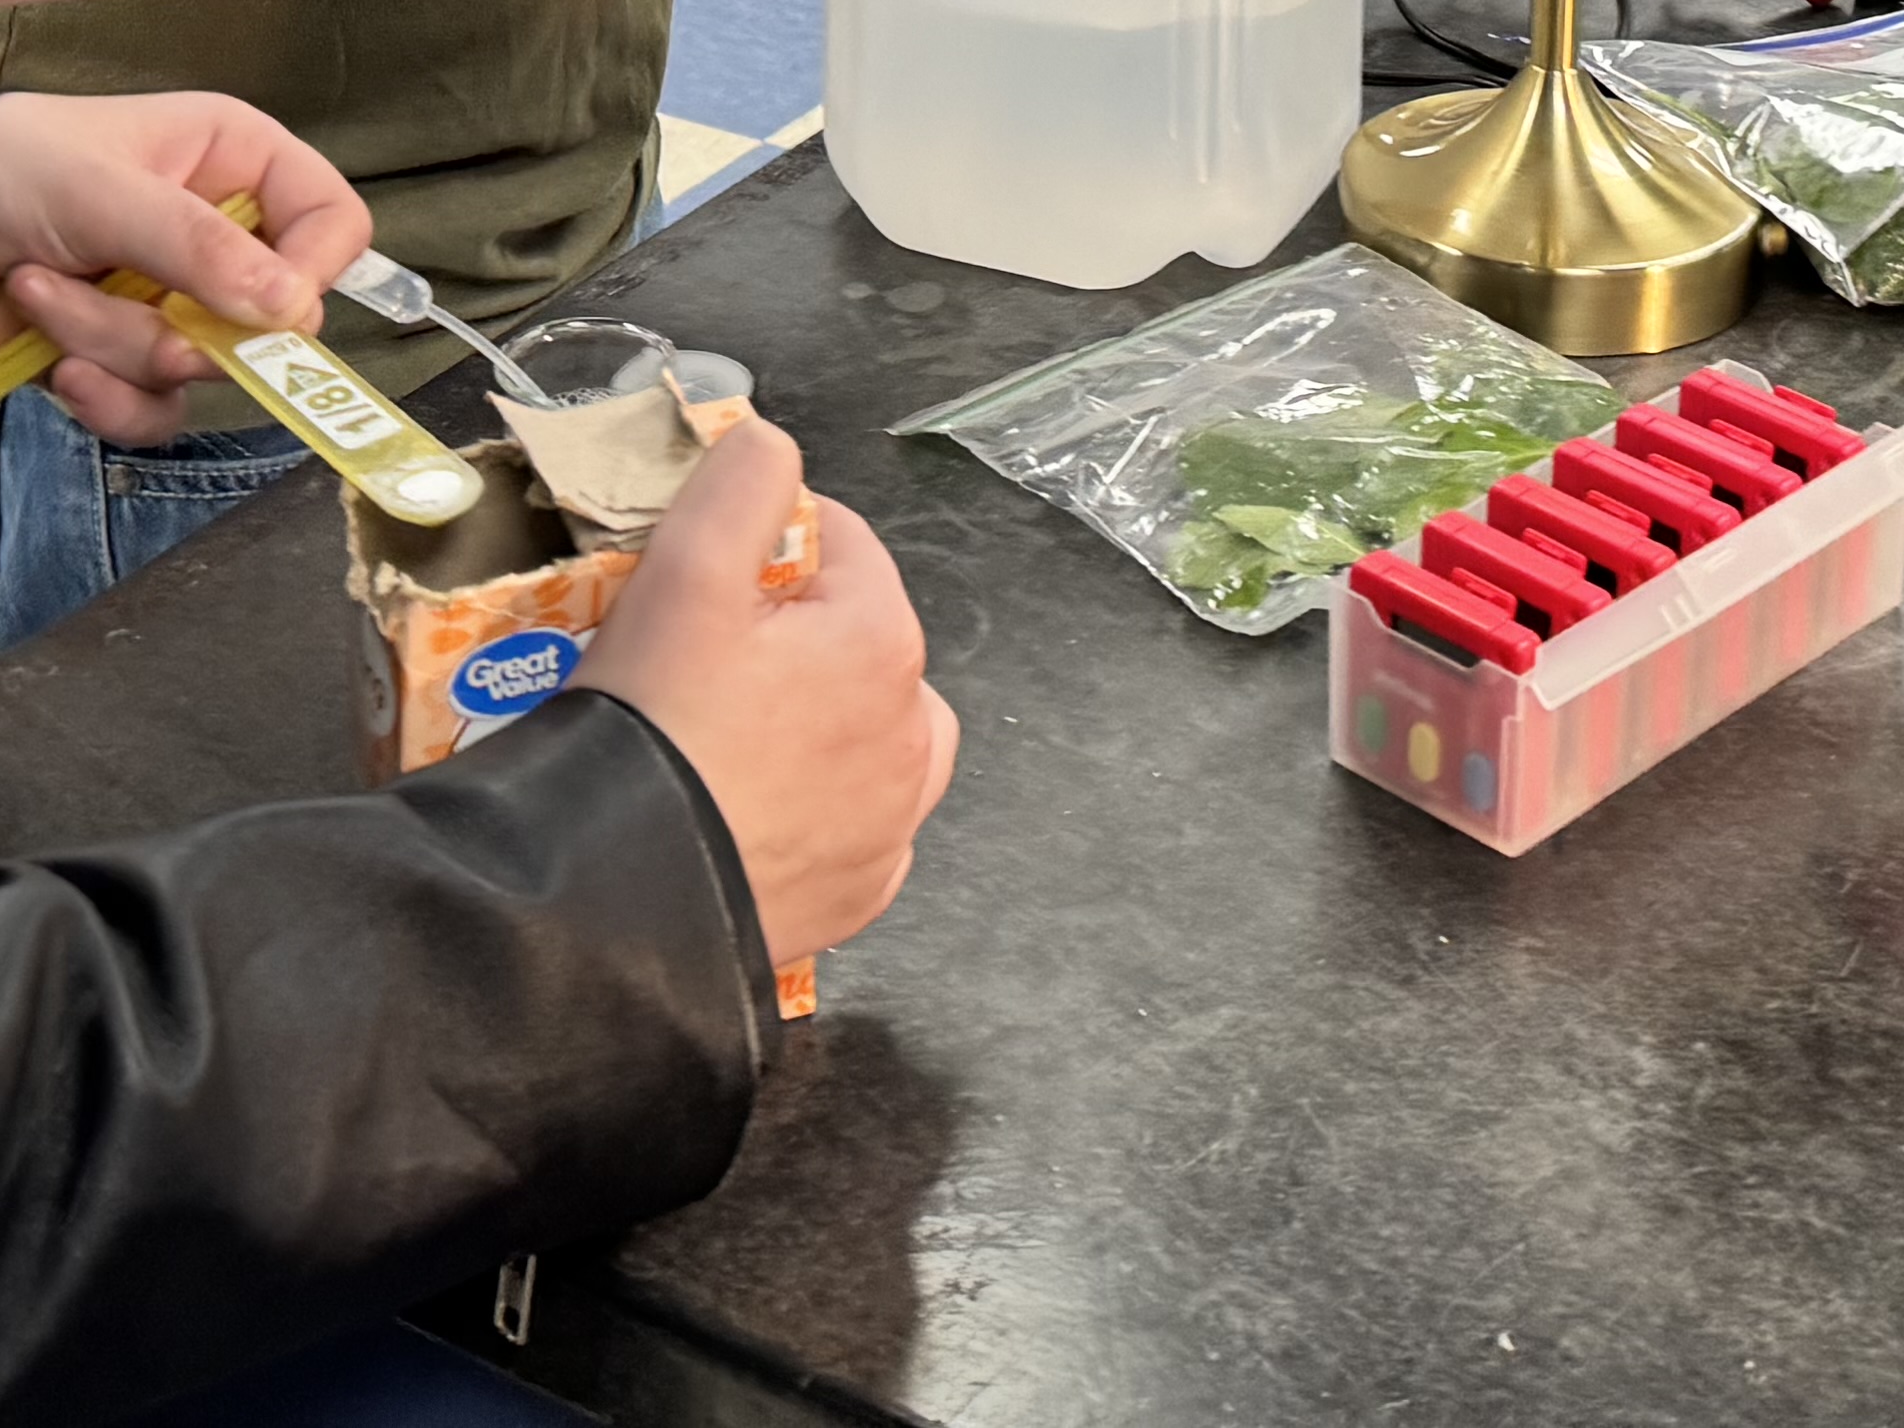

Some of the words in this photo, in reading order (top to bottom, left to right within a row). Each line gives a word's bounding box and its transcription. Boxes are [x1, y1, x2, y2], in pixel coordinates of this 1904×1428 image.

[307, 385, 382, 433] 1/8
[465, 644, 561, 691] Great
[487, 666, 561, 702] Value
